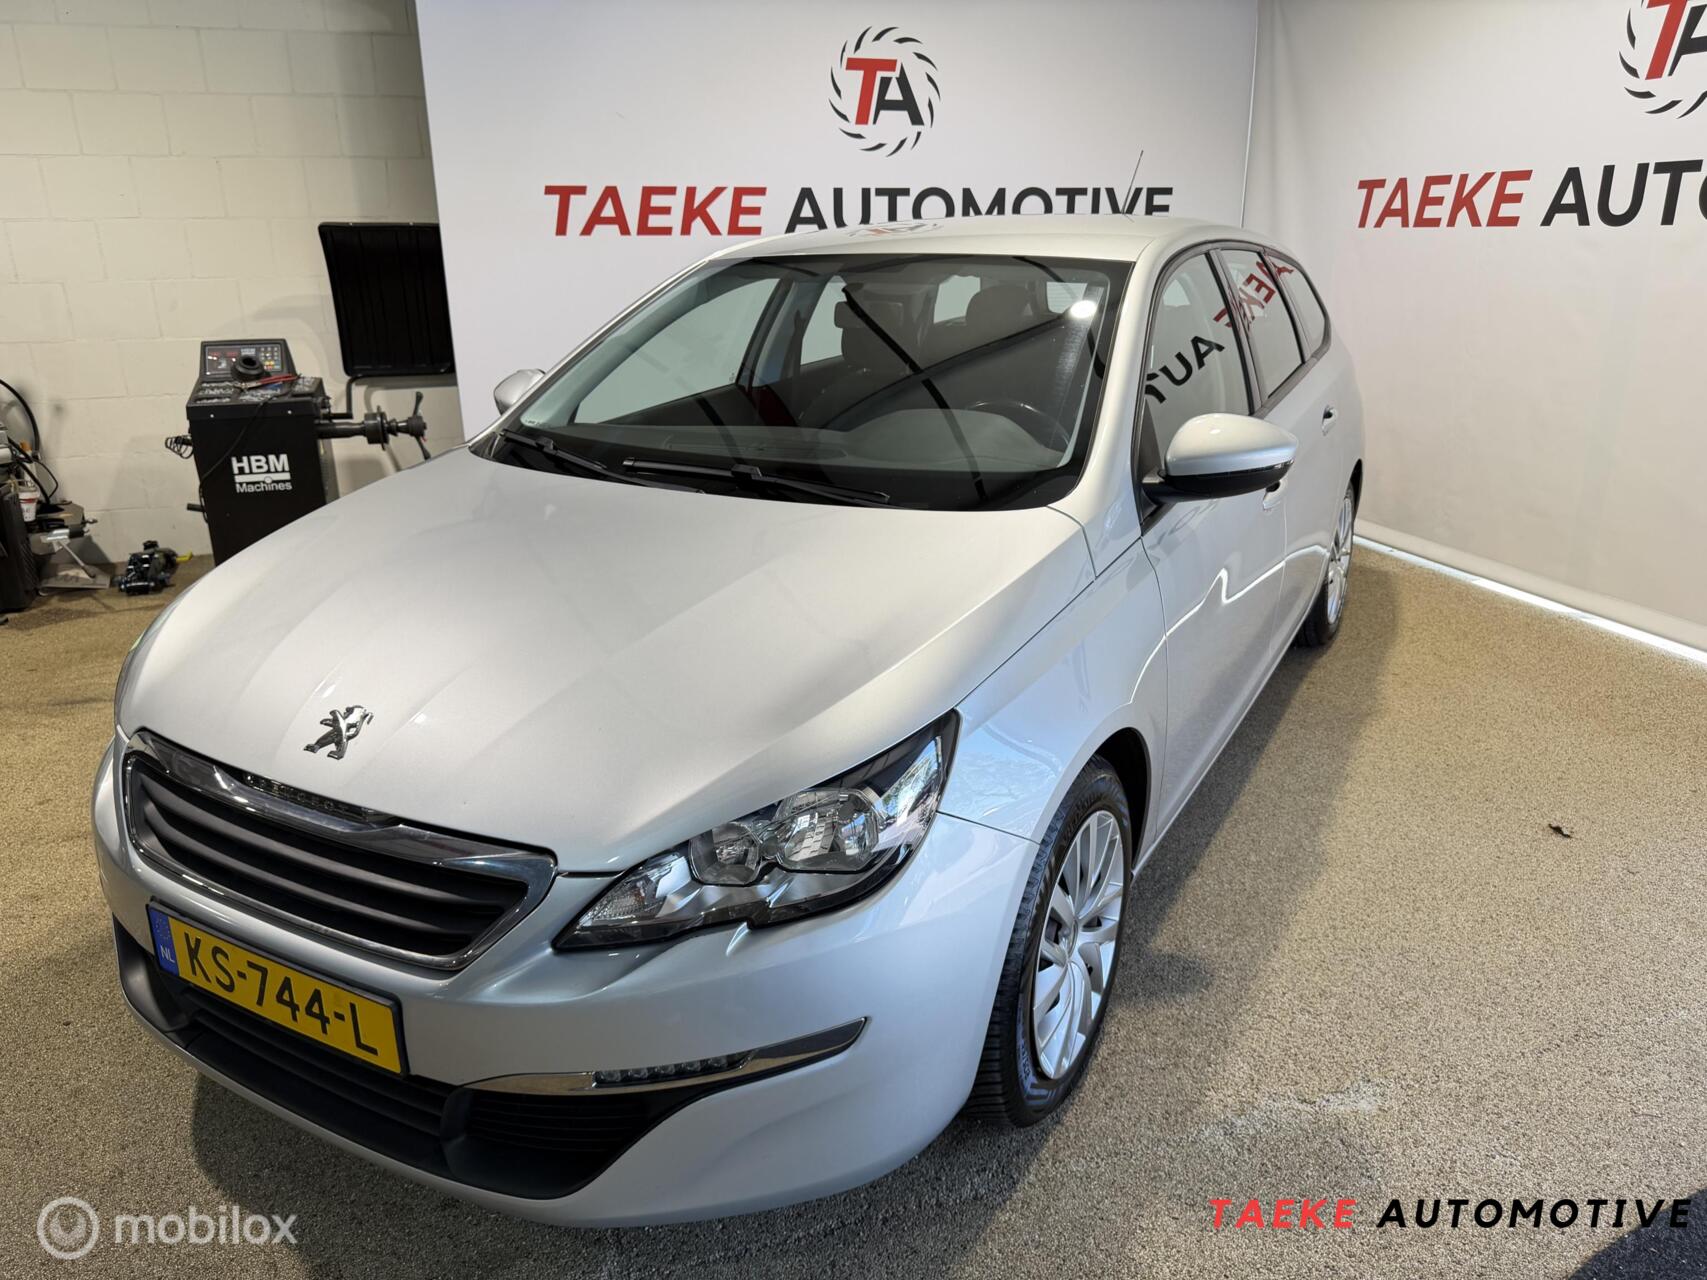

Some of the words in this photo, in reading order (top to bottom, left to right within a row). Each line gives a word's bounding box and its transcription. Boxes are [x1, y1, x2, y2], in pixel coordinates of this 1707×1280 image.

[845, 57, 925, 126] TA
[544, 185, 767, 236] TAEKE
[784, 187, 1173, 234] AUTOMOTIVE
[1356, 169, 1533, 229] TAEKE
[1540, 159, 1707, 227] AUT
[231, 453, 290, 474] HBM
[235, 482, 293, 493] Machines
[160, 945, 176, 963] NL
[184, 932, 379, 1056] KS-744-L
